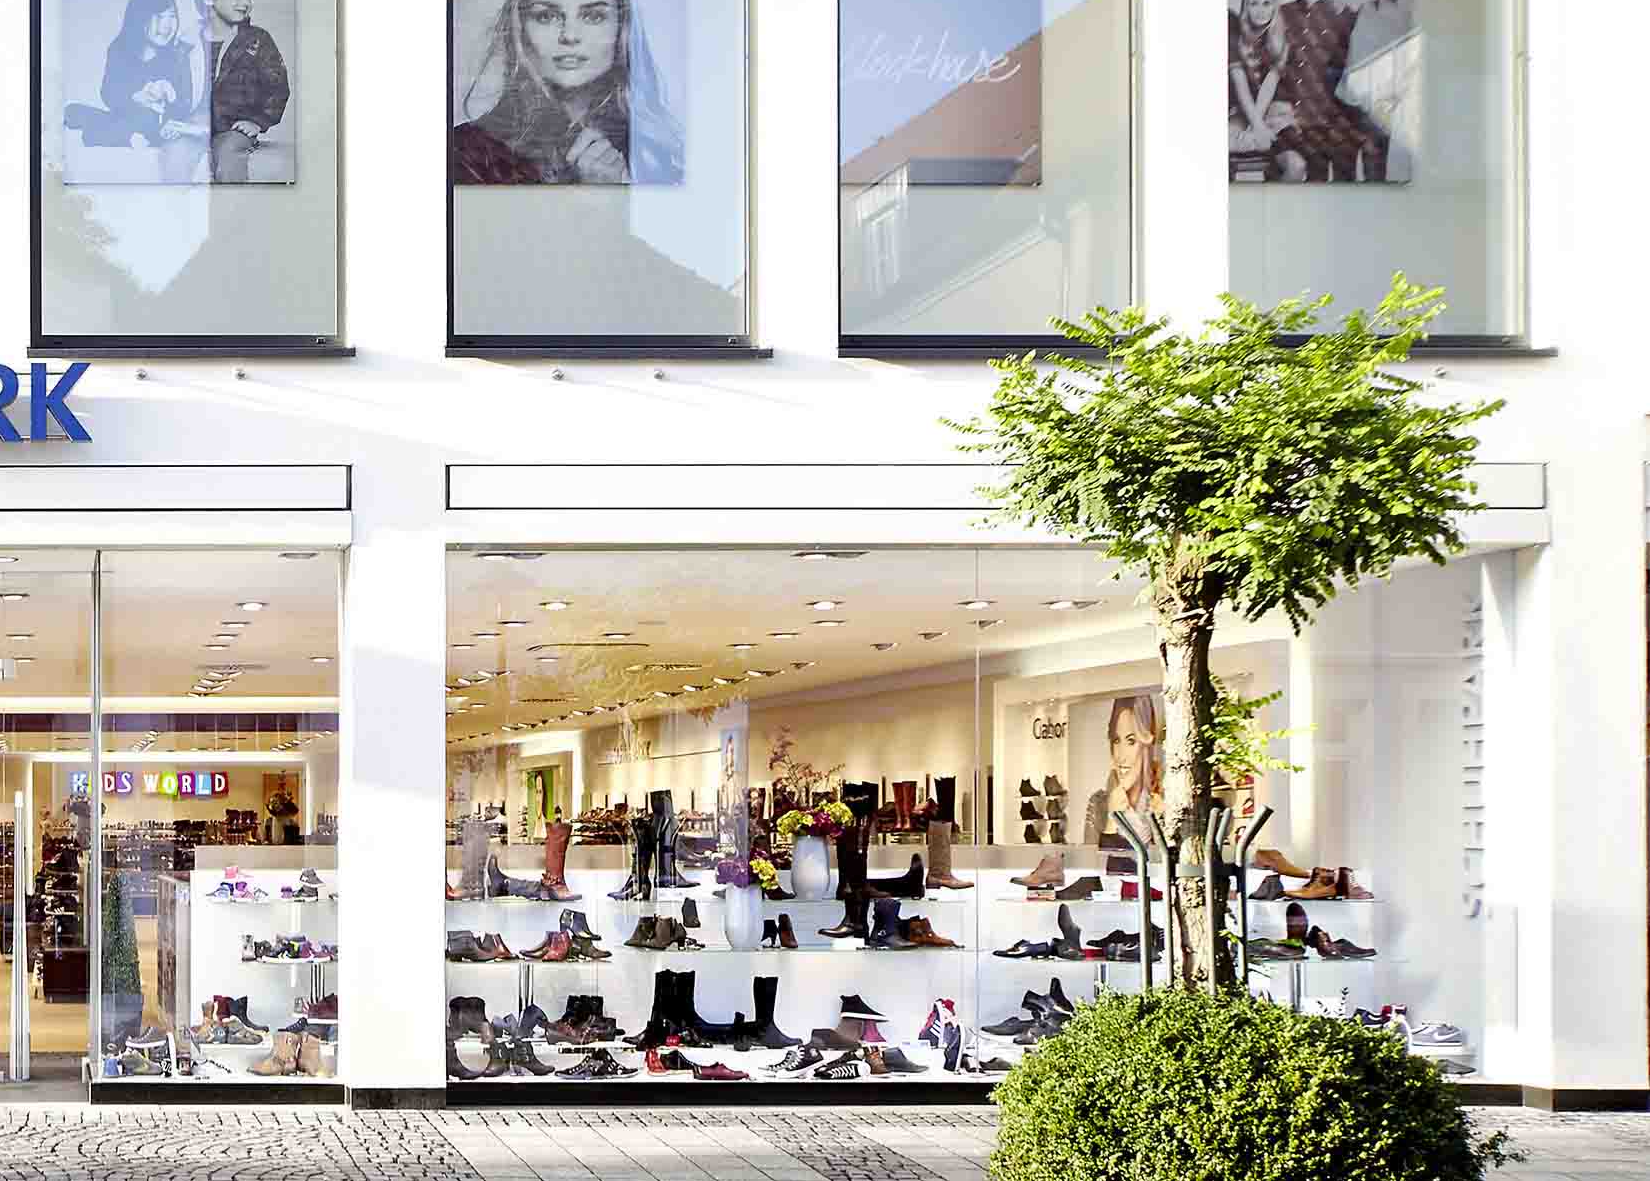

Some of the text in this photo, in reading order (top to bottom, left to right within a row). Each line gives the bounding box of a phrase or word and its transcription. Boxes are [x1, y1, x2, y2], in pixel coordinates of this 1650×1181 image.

[1032, 717, 1067, 740] Gabor
[72, 772, 227, 796] KDS WORLD
